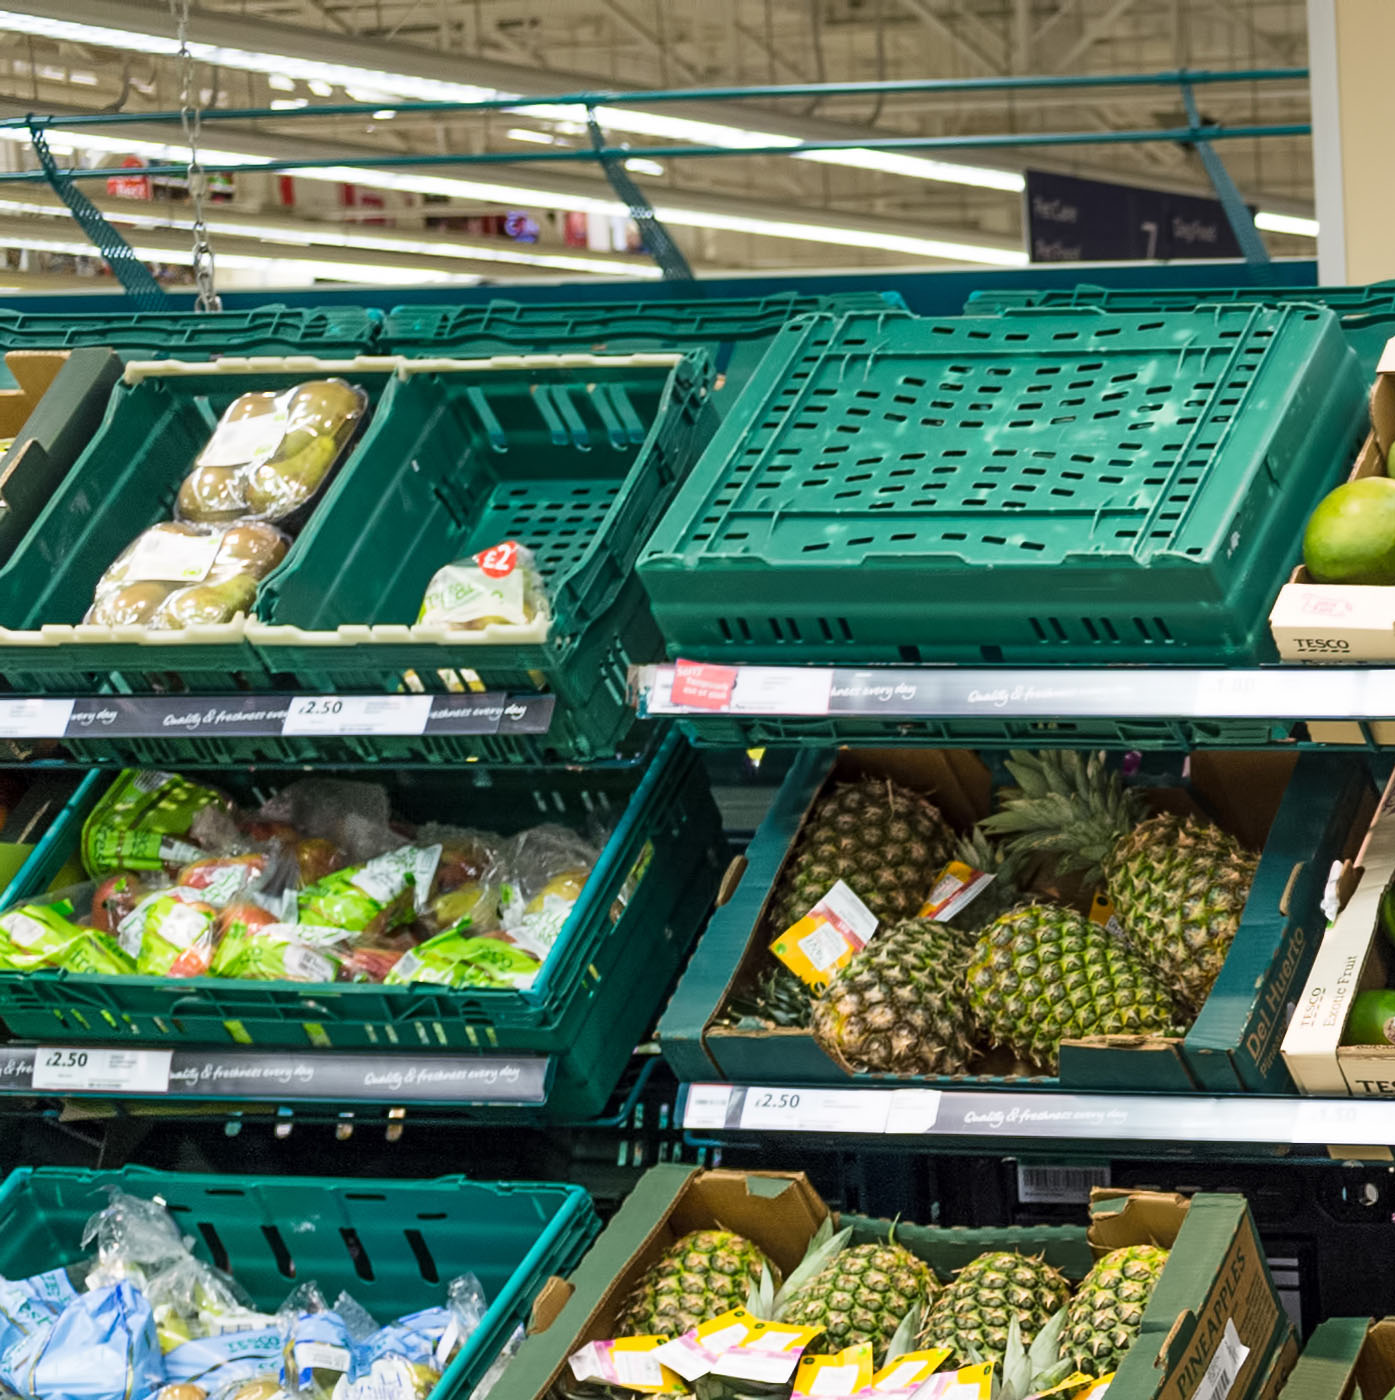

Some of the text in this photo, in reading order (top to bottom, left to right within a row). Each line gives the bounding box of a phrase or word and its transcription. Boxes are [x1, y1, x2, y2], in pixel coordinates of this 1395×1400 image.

[482, 544, 512, 571] £2
[1297, 638, 1350, 650] TESCO
[300, 700, 343, 715] £2.50
[1246, 1022, 1275, 1062] Del
[1267, 927, 1305, 1010] Huerto
[1300, 987, 1322, 1027] TESCO
[46, 1052, 88, 1068] £2.50
[754, 1093, 800, 1110] £2.50
[1175, 1247, 1247, 1400] PINEAPPLES
